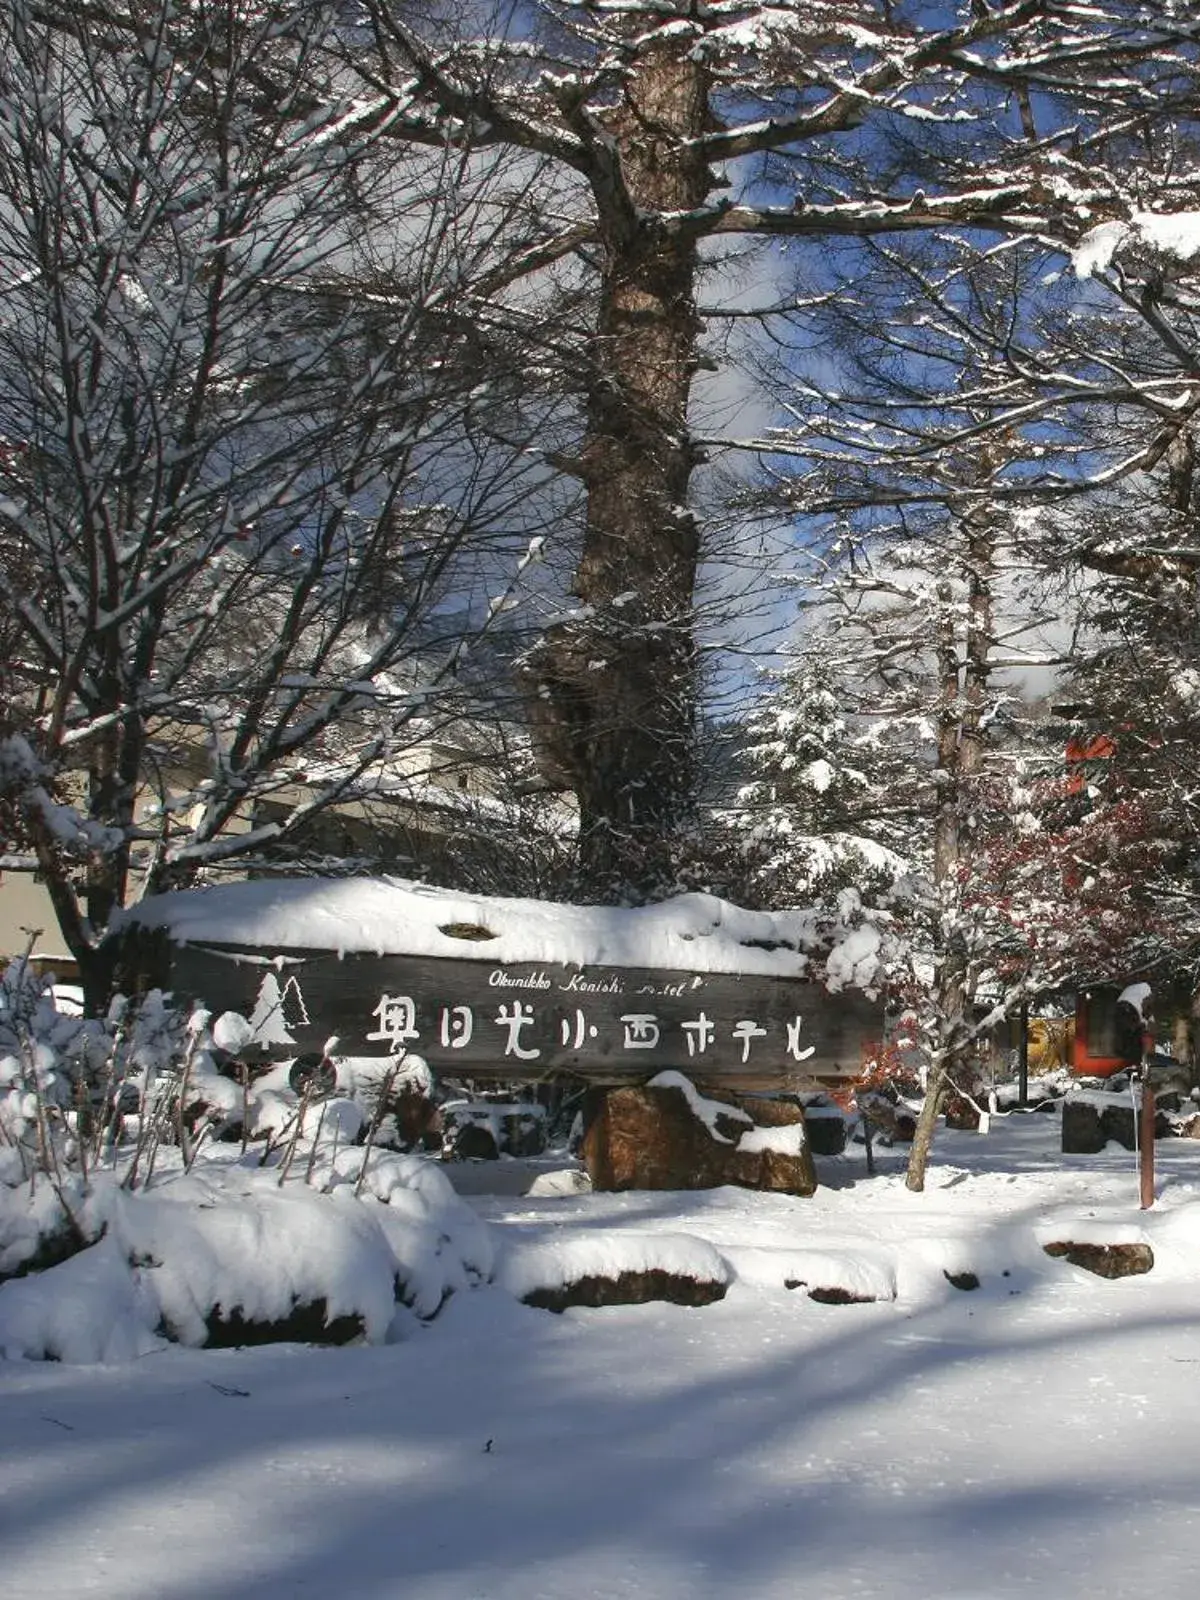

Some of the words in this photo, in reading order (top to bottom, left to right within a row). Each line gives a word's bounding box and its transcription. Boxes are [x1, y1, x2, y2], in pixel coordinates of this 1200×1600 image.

[488, 969, 551, 990] Okunikko
[559, 974, 625, 994] Konishi
[365, 994, 817, 1062] 奥日光小西ホテル
